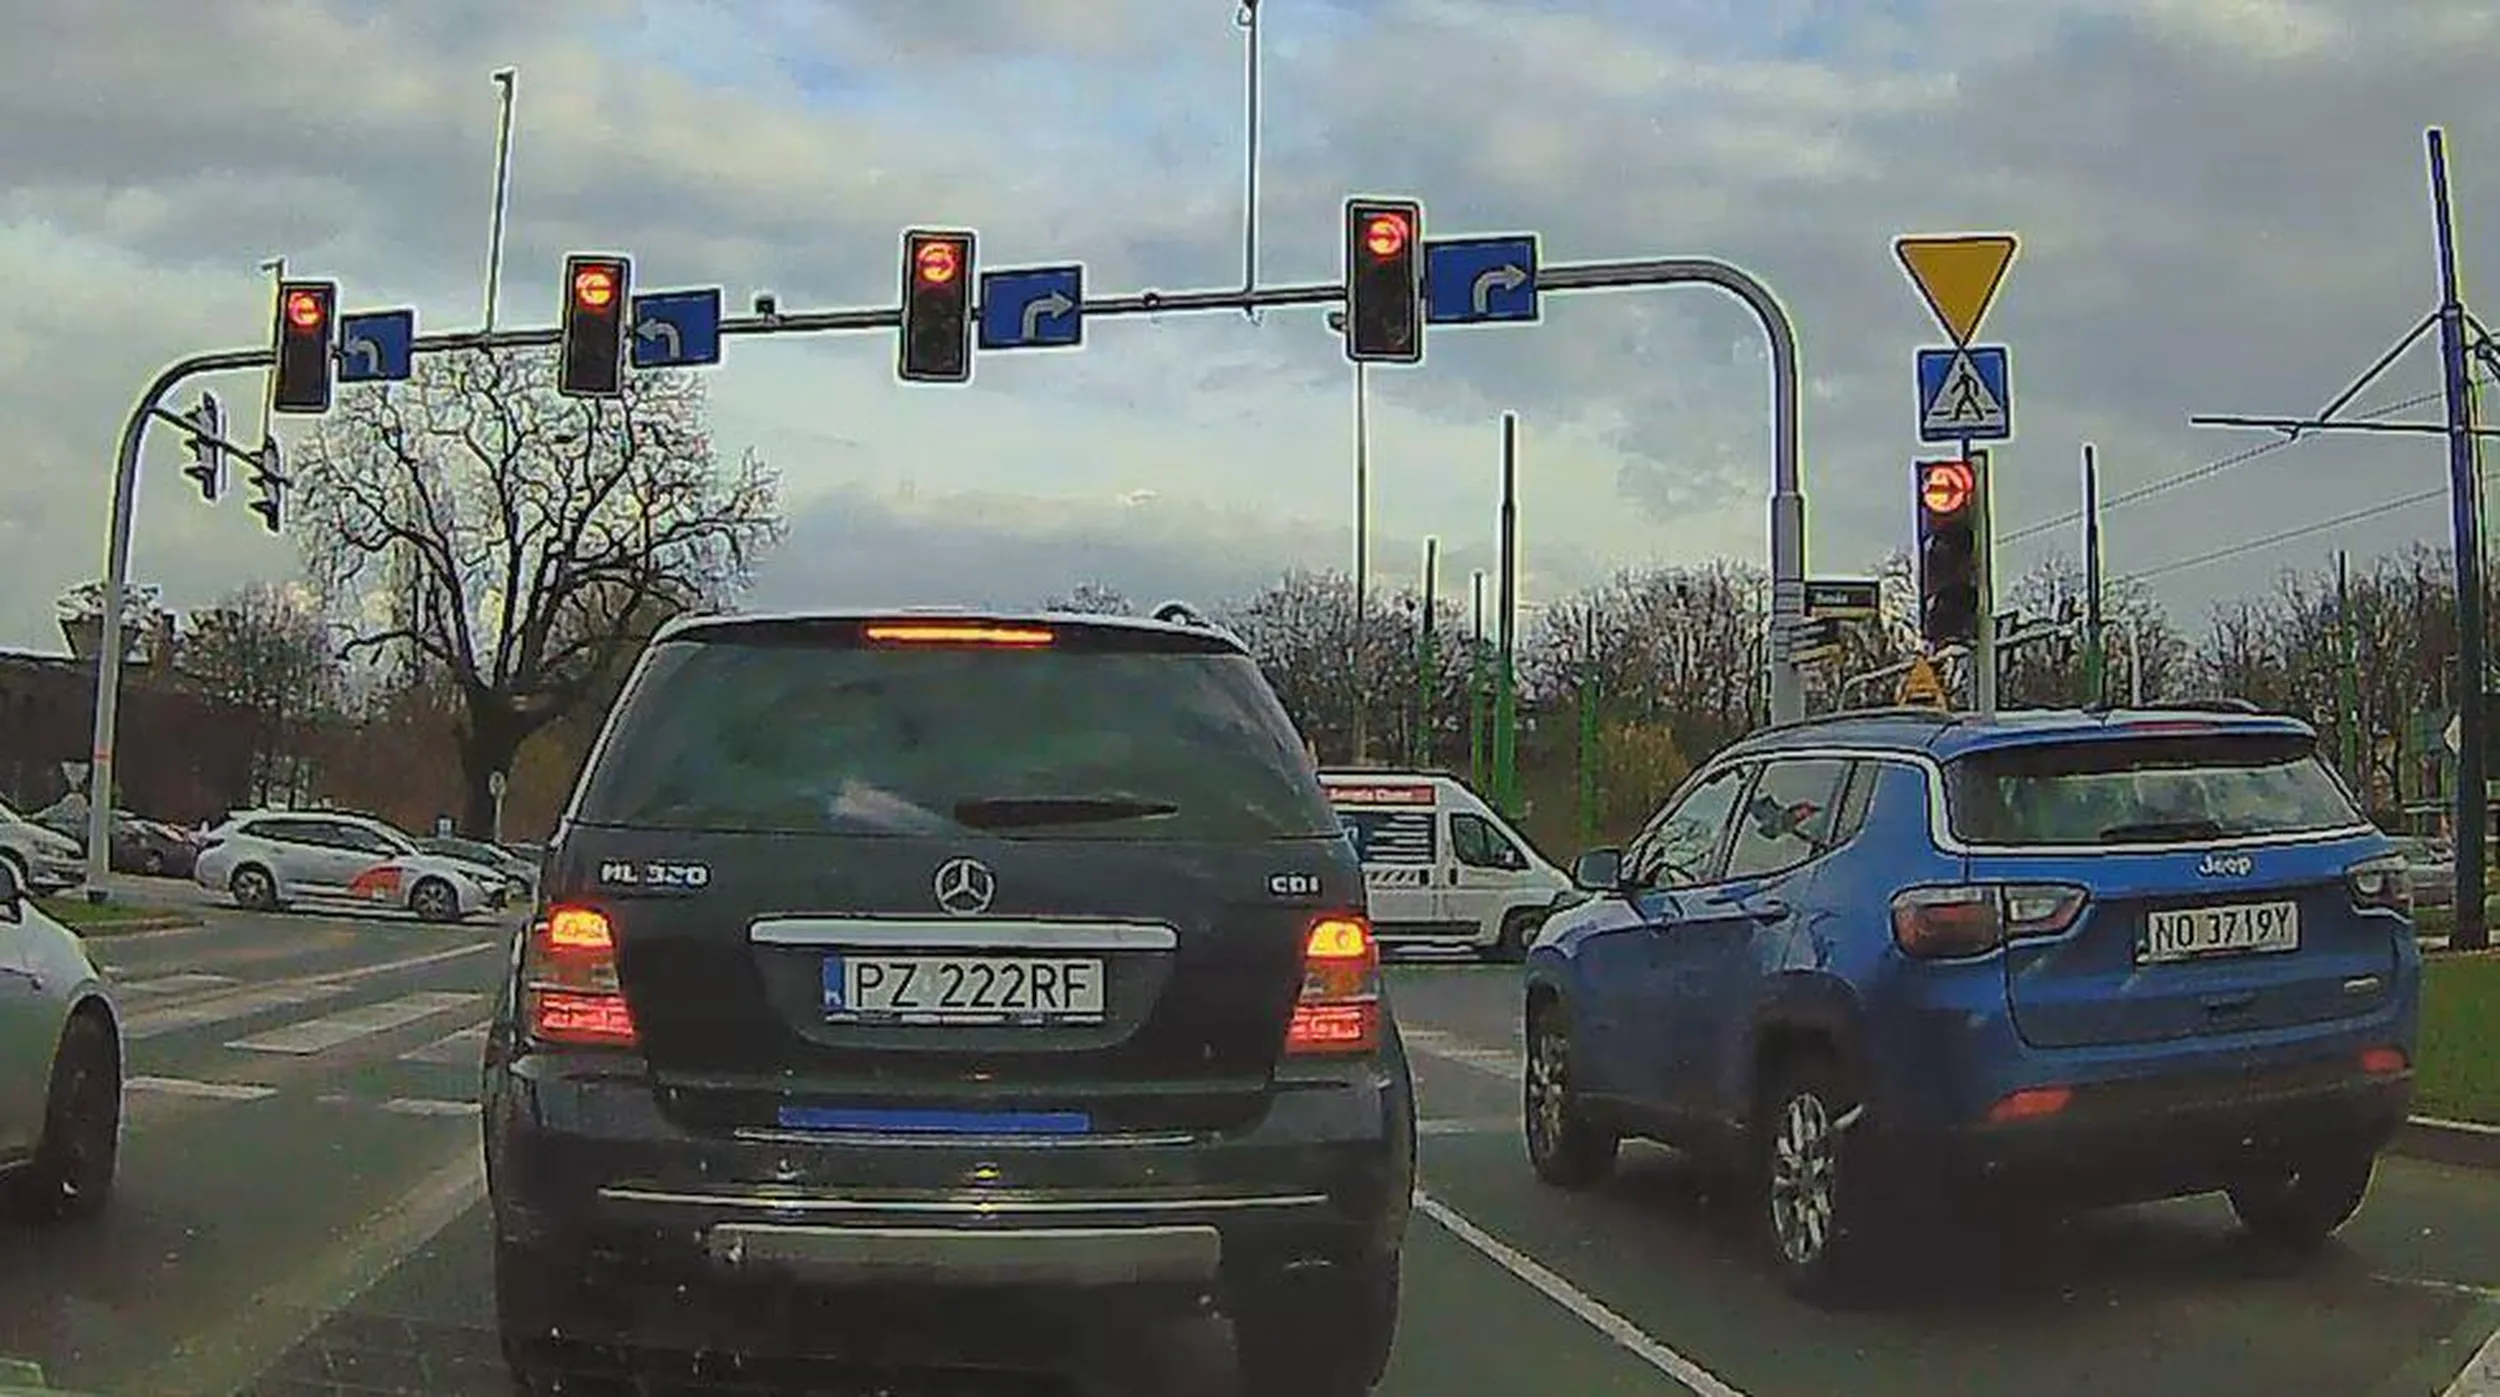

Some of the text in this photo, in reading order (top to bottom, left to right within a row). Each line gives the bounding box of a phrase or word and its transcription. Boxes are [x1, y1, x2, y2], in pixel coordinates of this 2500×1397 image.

[2200, 855, 2251, 875] Jeep
[1271, 876, 1319, 892] CDI
[2207, 907, 2290, 944] 3719Y
[857, 963, 1092, 1008] PZ 222RF
